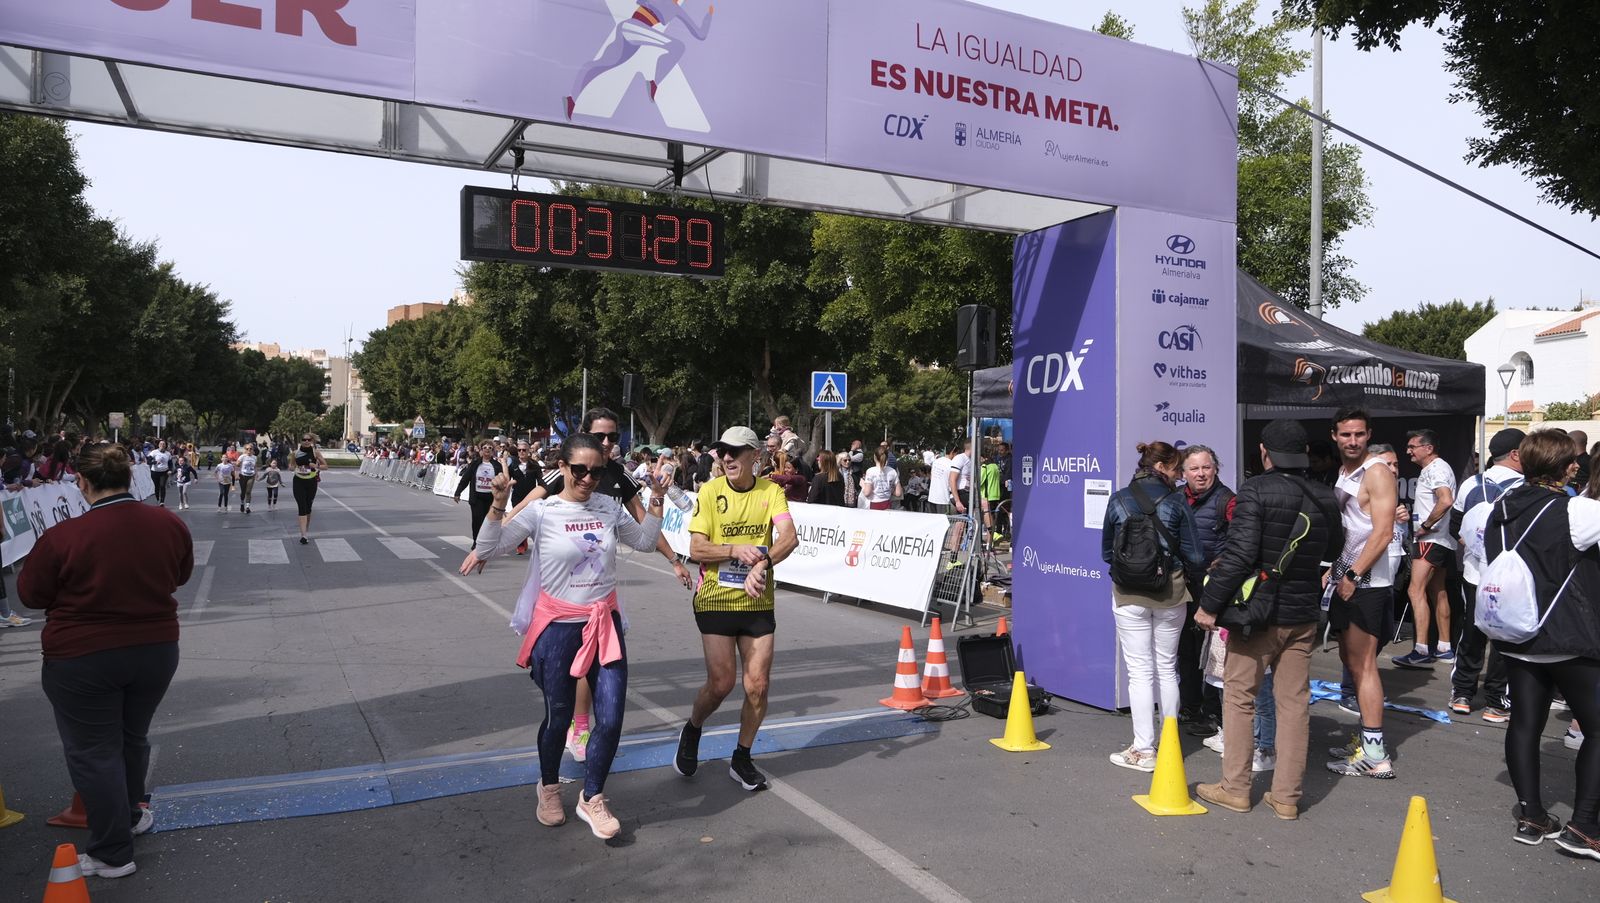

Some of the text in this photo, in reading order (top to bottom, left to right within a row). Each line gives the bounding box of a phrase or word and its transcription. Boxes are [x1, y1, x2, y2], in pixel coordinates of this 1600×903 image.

[916, 22, 1082, 82] LA IGUALDAD
[871, 59, 1120, 132] ES NUESTRA META.
[883, 113, 929, 141] CDX
[976, 127, 1022, 146] ALMERÍA
[511, 199, 712, 269] 00:31:29
[1155, 254, 1206, 270] HYUNDAI
[1168, 292, 1210, 307] cajamar
[1158, 330, 1194, 351] CASI
[1026, 340, 1094, 395] CDX
[1170, 365, 1207, 380] vithas
[1162, 409, 1206, 426] aqualia
[1042, 453, 1101, 473] ALMERÍA
[1041, 473, 1070, 484] CIUDAD
[565, 521, 604, 533] MUJER
[797, 524, 846, 548] ALMERÍA
[793, 544, 819, 558] IUDAD
[871, 533, 934, 559] ALMERÍA
[870, 554, 901, 570] CIUDAD
